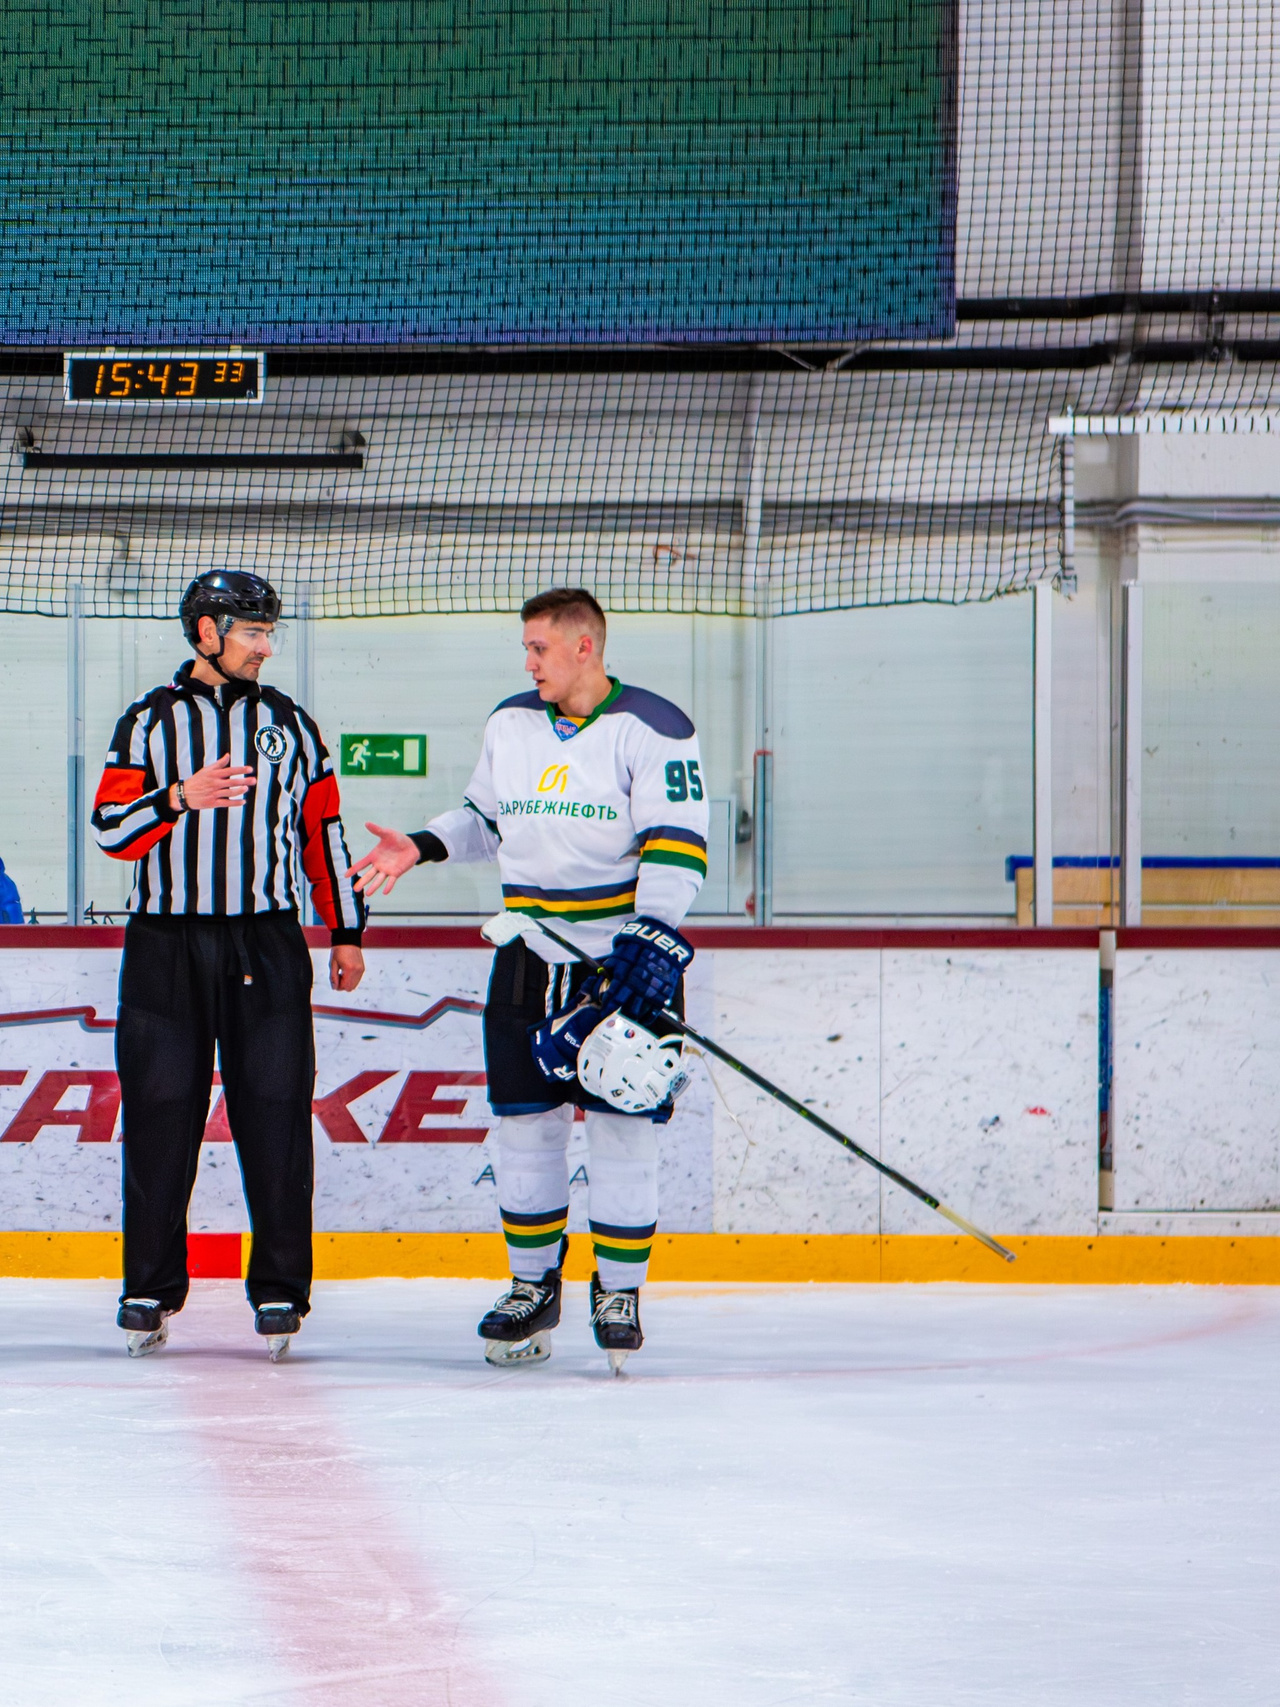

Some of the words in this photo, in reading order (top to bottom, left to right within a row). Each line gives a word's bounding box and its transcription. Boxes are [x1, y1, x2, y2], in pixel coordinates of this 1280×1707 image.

[94, 362, 199, 396] 15:43
[214, 362, 245, 382] 33
[664, 760, 704, 803] 95
[498, 800, 618, 820] ЗАРУБЕЖНЕФТЬ
